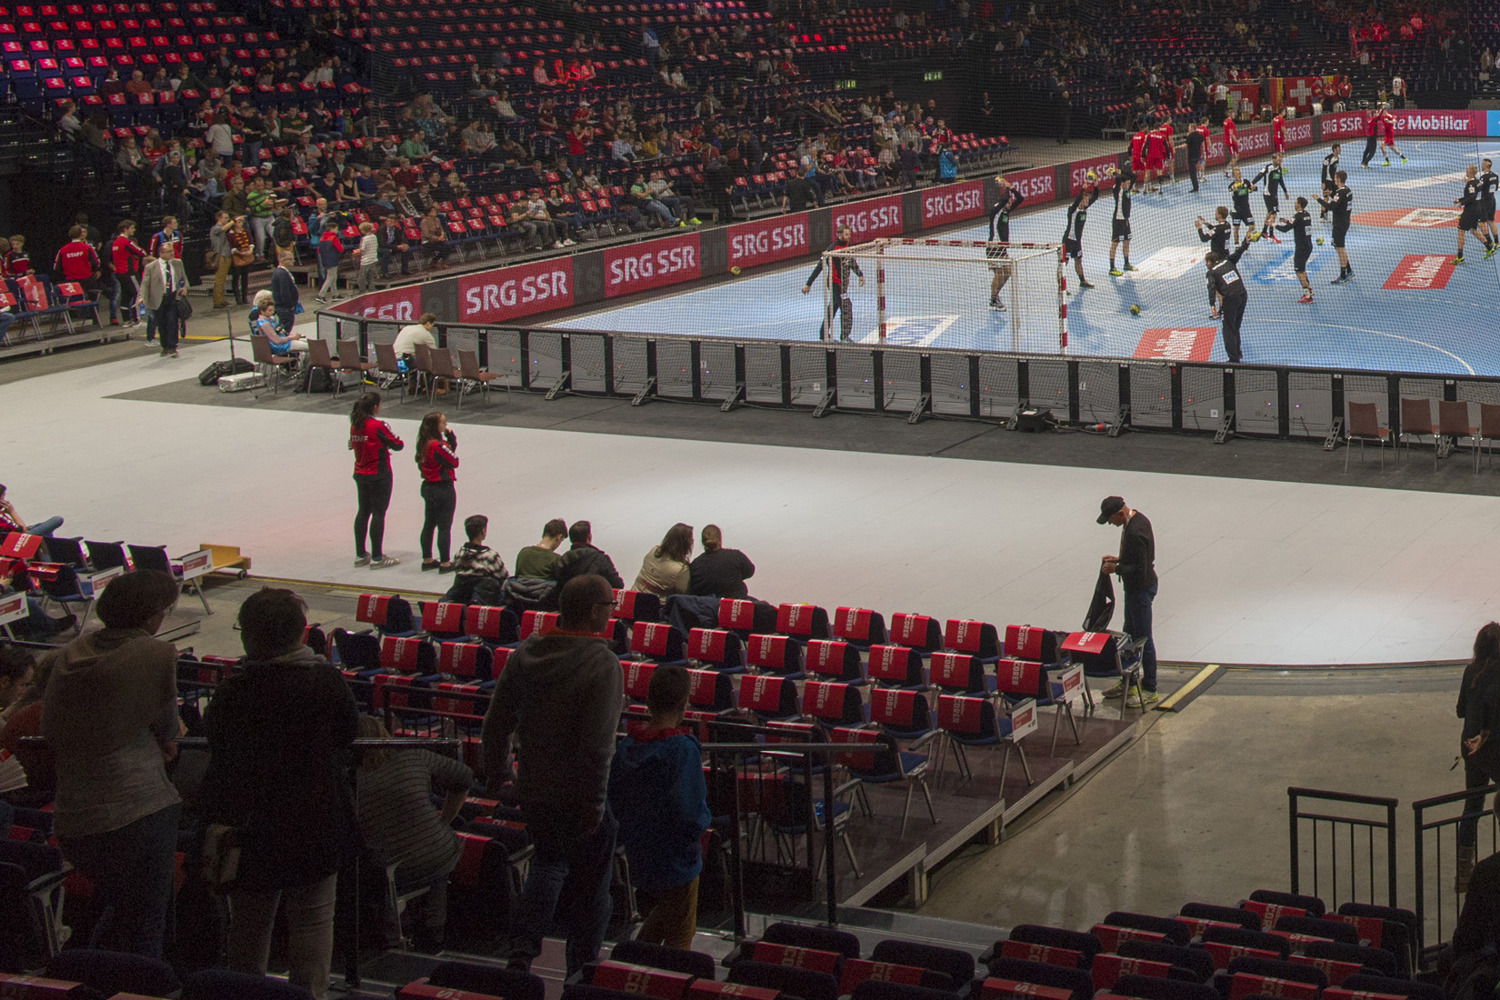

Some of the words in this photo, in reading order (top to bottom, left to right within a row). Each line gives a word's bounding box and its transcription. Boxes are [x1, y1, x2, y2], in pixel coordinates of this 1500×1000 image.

[1322, 119, 1338, 135] SRG
[1339, 116, 1363, 132] SSR
[1407, 115, 1469, 131] Mobiliar
[1255, 132, 1270, 148] SSR
[1031, 175, 1053, 197] SSR
[926, 194, 953, 218] SRG
[956, 189, 981, 211] SSR
[870, 205, 900, 229] SSR
[732, 231, 768, 259] SRG
[772, 223, 806, 249] SSR
[610, 253, 653, 284] SRG
[657, 245, 696, 273] SSR
[466, 280, 517, 315] SRG
[522, 271, 568, 304] SSR
